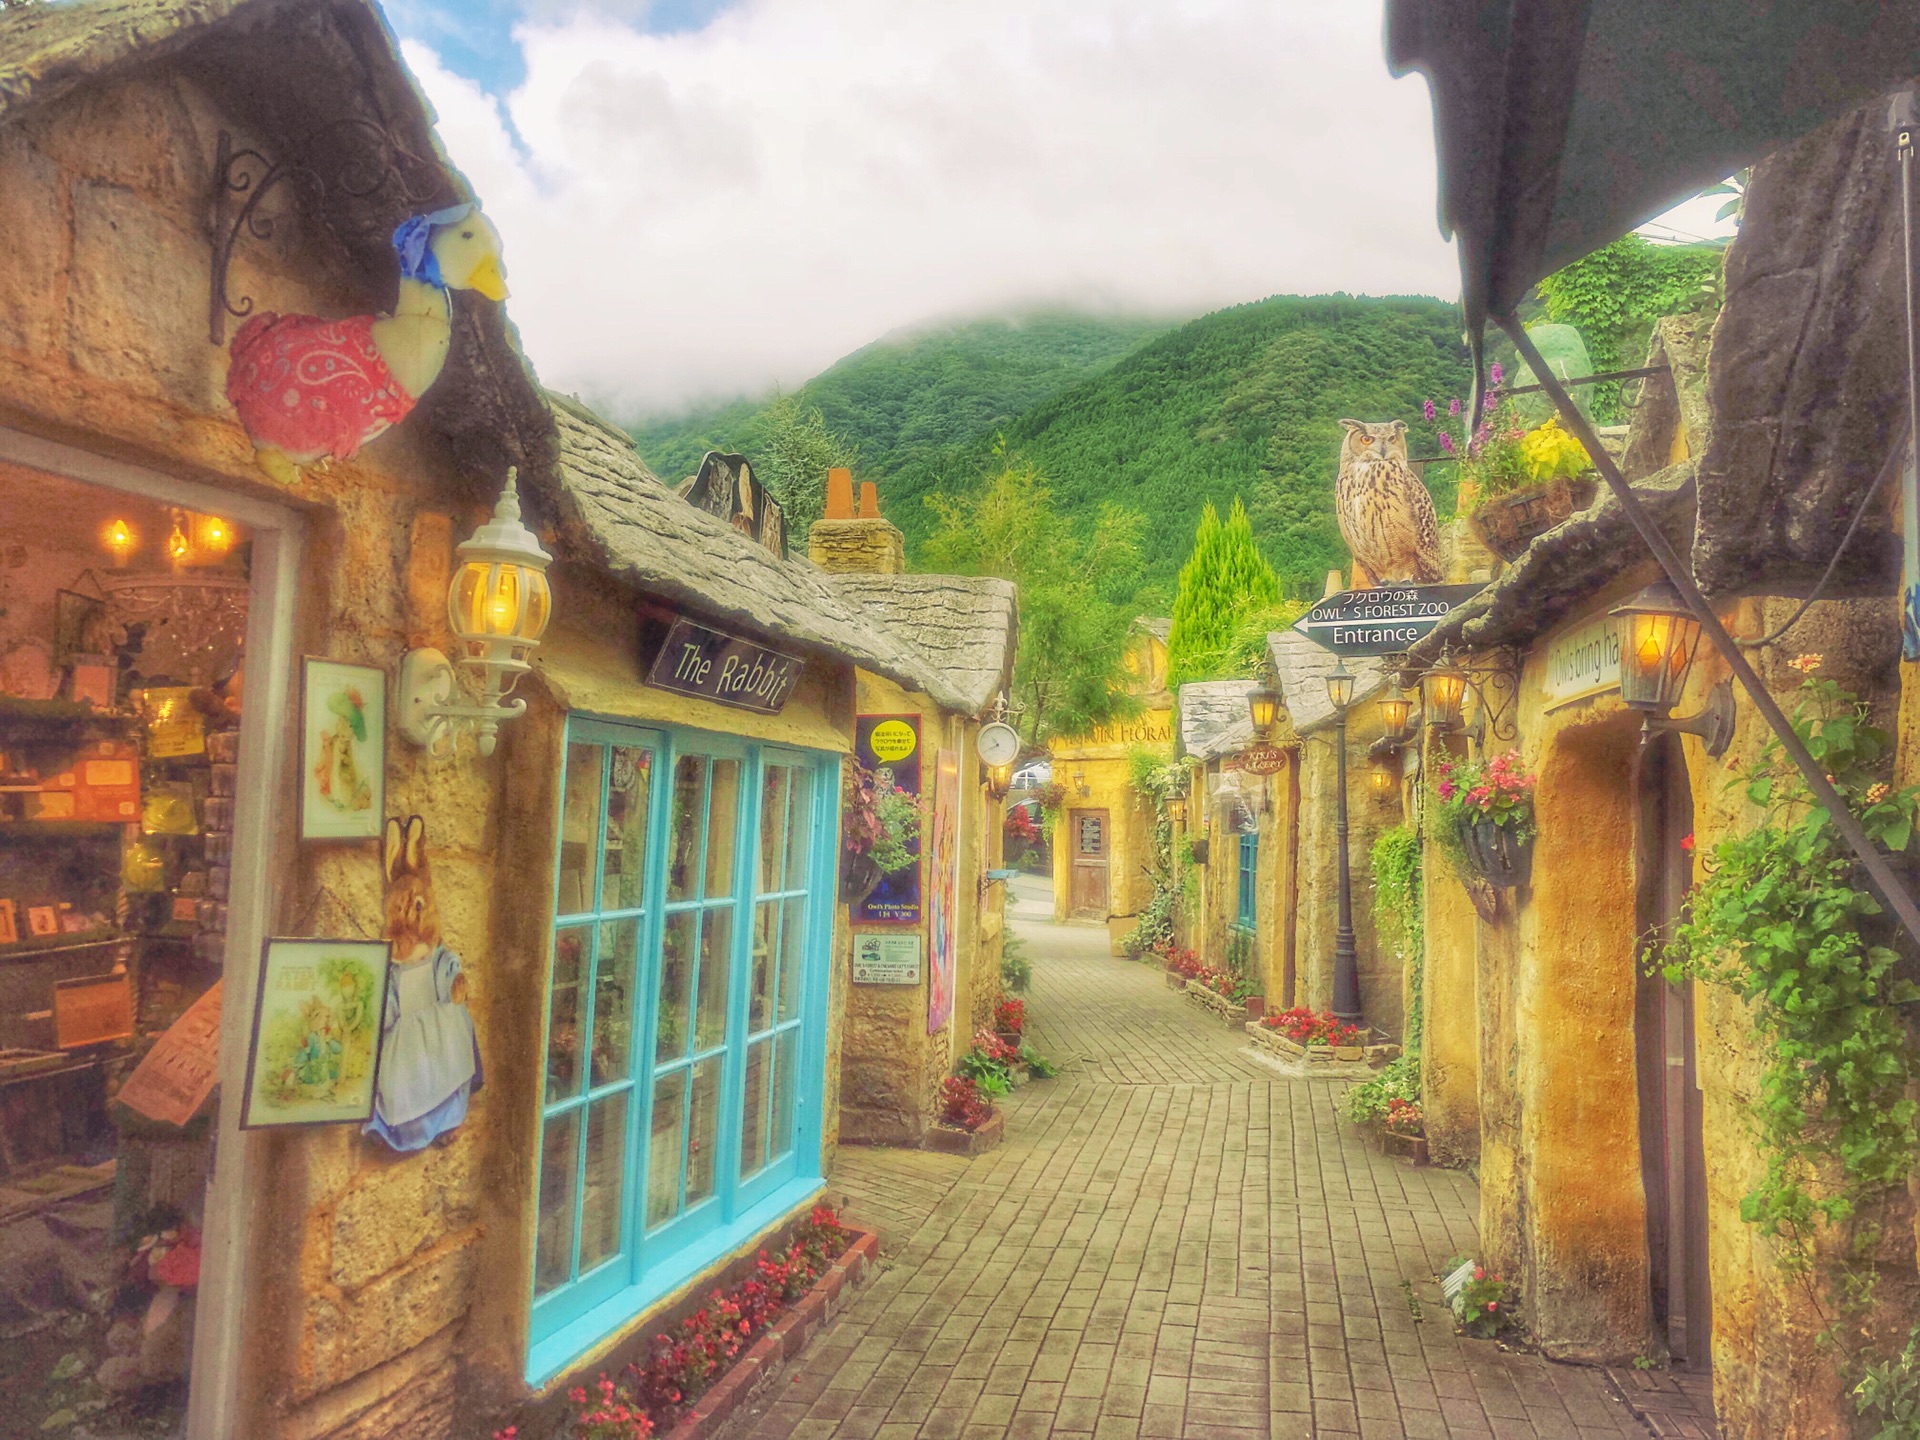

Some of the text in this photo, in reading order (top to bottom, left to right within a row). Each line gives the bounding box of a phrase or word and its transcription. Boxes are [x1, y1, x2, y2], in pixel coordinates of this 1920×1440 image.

[1343, 589, 1419, 604] フクロウの森
[1365, 603, 1415, 619] FOREST
[1418, 601, 1449, 615] ZOO
[1333, 627, 1418, 645] Entrance
[1575, 631, 1601, 684] bring
[674, 642, 788, 707] The Rabbit
